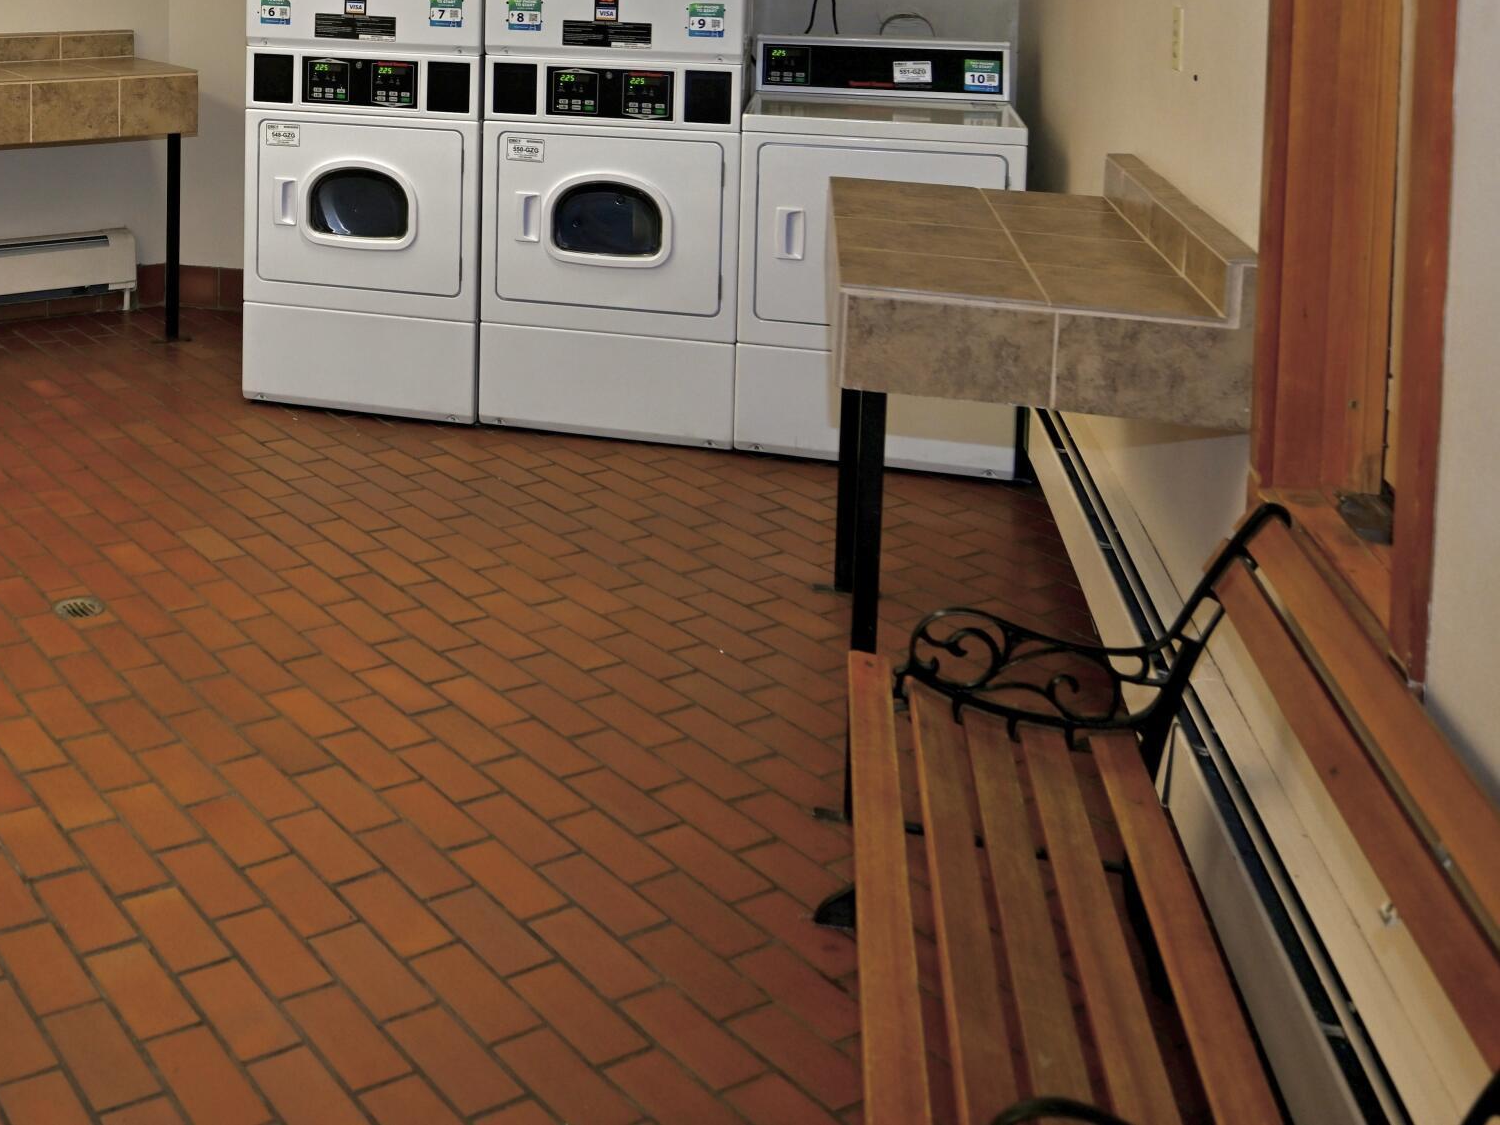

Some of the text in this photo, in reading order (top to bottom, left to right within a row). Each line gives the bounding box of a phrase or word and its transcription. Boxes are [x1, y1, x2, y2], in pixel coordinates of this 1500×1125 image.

[268, 7, 275, 16] 6
[438, 9, 445, 19] 7
[517, 12, 524, 22] 8
[698, 19, 706, 29] 9
[970, 74, 985, 84] 10
